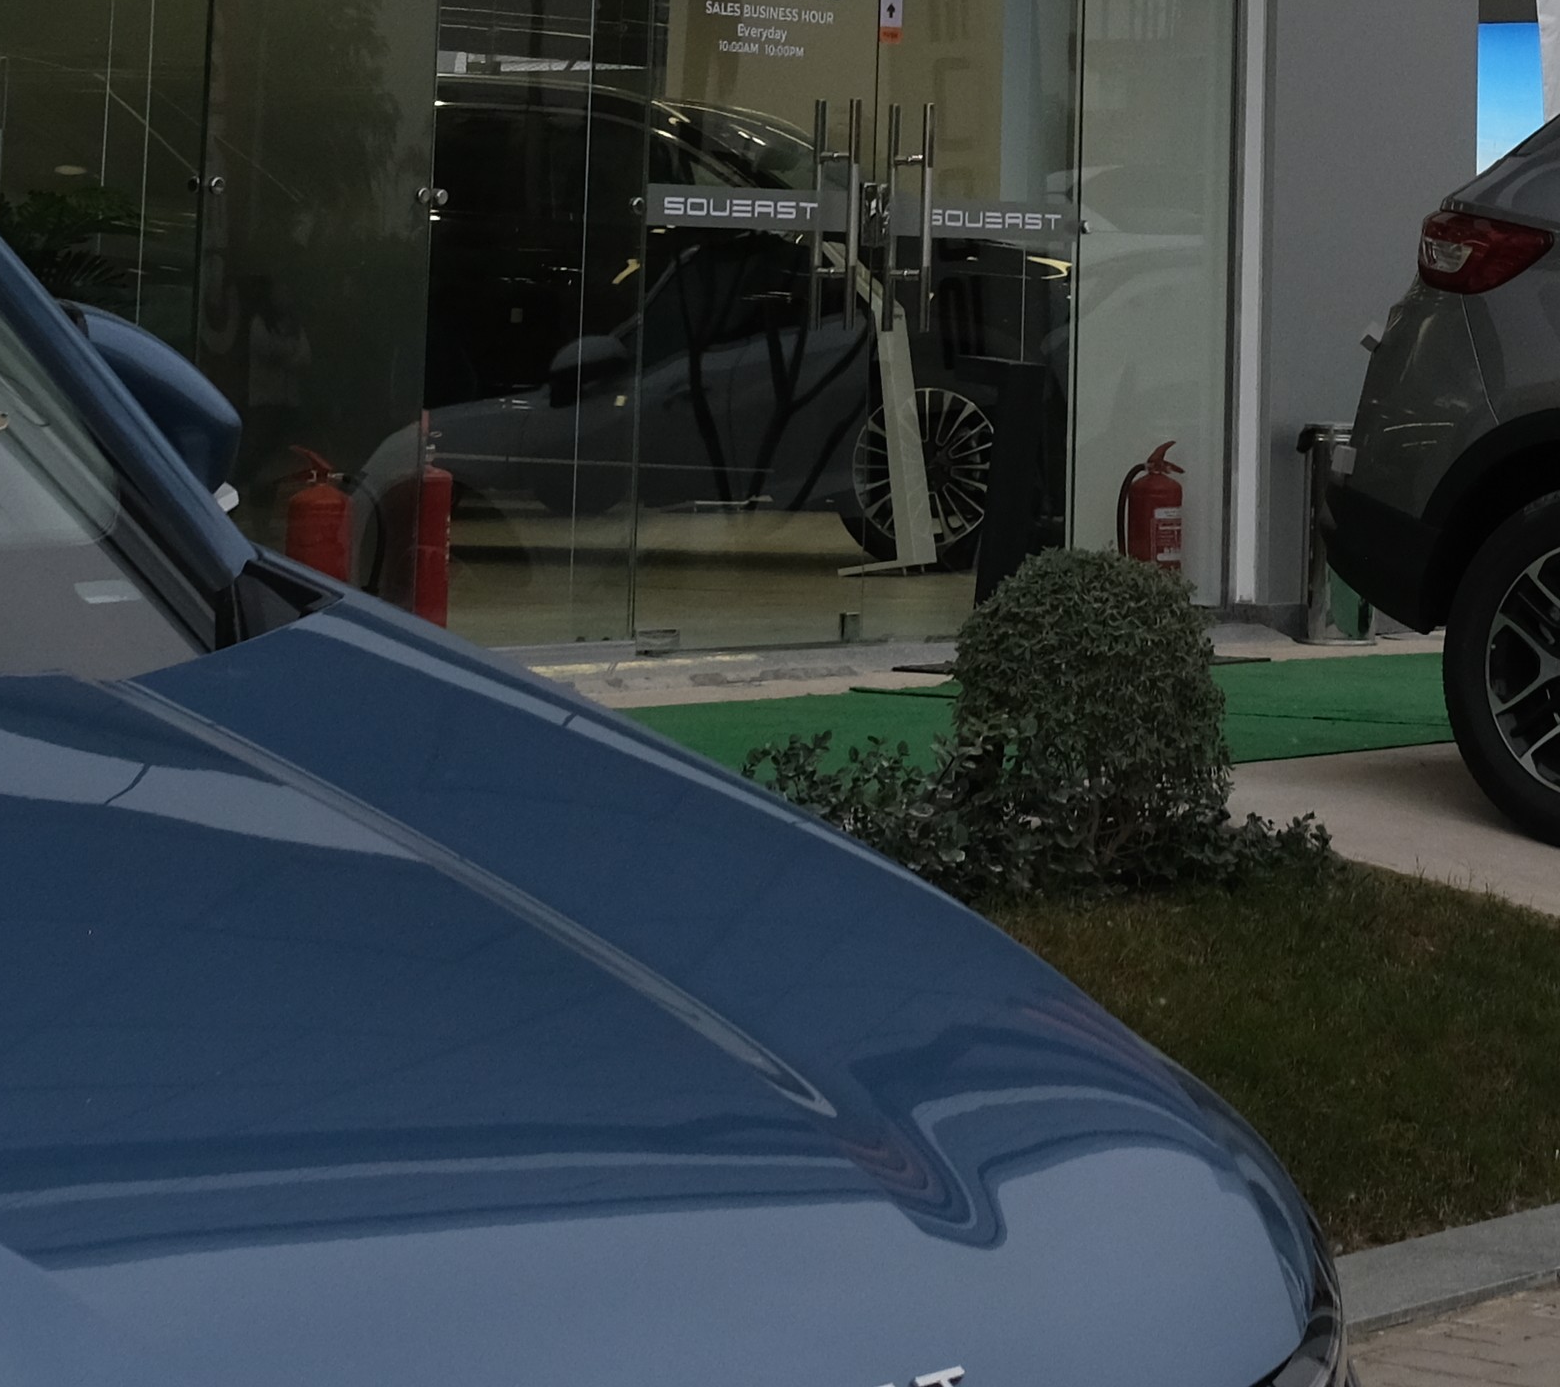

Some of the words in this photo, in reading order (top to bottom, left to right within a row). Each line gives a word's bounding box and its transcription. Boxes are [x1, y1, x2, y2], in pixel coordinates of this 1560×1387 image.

[706, 0, 740, 16] SALES
[743, 4, 798, 22] BUSINESS
[801, 10, 834, 24] HOUR
[737, 23, 787, 42] Everyday
[663, 196, 819, 220] SOUEAST
